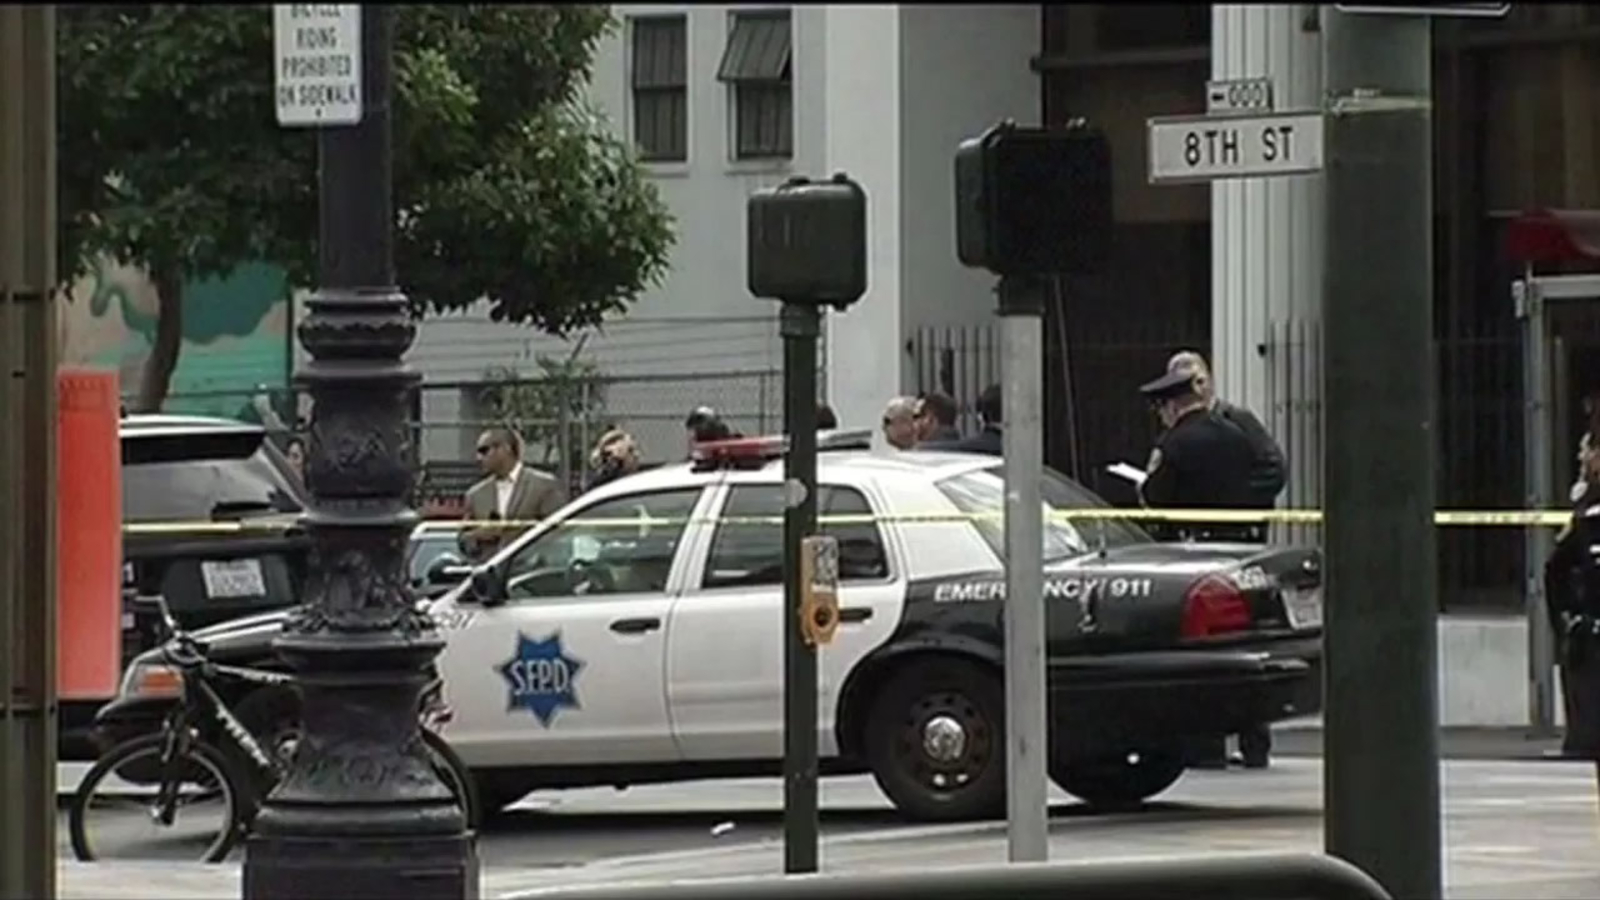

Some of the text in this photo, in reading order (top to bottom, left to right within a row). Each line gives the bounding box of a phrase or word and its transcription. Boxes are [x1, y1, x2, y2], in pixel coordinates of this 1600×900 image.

[296, 26, 338, 49] RIDING
[283, 54, 350, 78] PROHIBITED
[299, 84, 357, 106] SIDEWALK
[1185, 125, 1294, 167] 8TH ST
